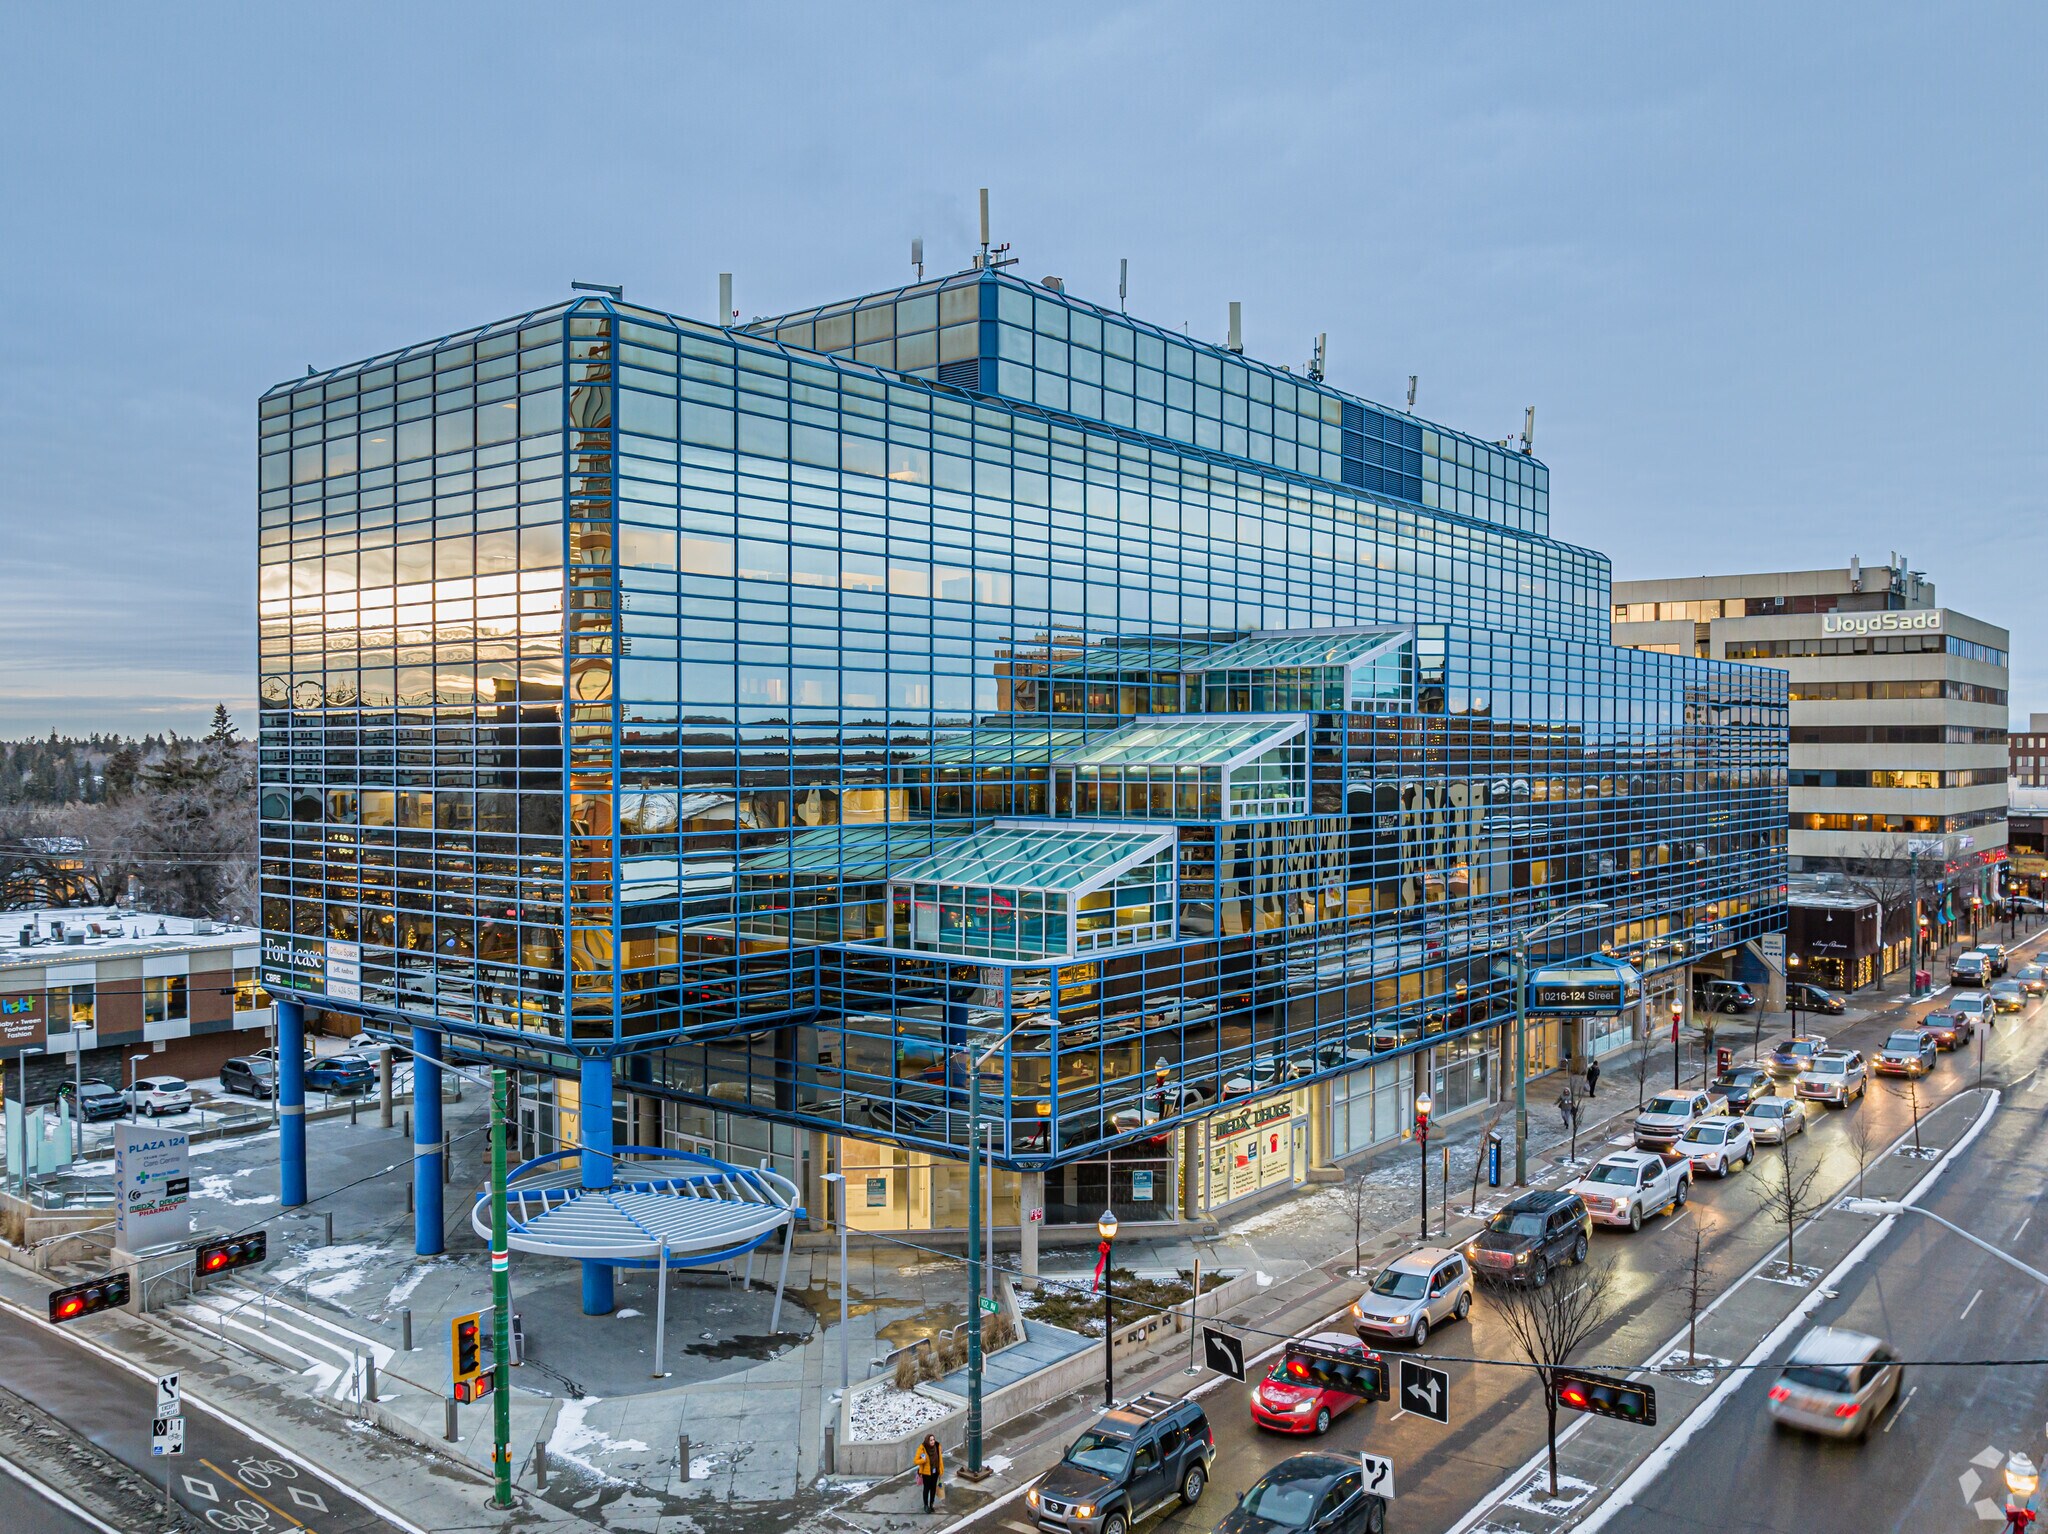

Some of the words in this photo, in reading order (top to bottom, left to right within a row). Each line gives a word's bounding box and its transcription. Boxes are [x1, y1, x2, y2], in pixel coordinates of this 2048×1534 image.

[1824, 612, 1941, 635] LloydSadd
[265, 938, 286, 962] For
[287, 941, 322, 968] Lease
[343, 947, 358, 958] Space
[265, 972, 281, 984] CBRE
[1540, 991, 1586, 1001] 10216-124
[1587, 991, 1614, 1000] Street
[4, 1025, 35, 1033] Footwear
[7, 1031, 33, 1039] Fashion
[1254, 1101, 1291, 1127] DRUGS
[128, 1140, 166, 1154] PLAZA
[168, 1136, 186, 1147] 124
[159, 1195, 188, 1207] DRUGS
[138, 1204, 178, 1217] PHARMACY
